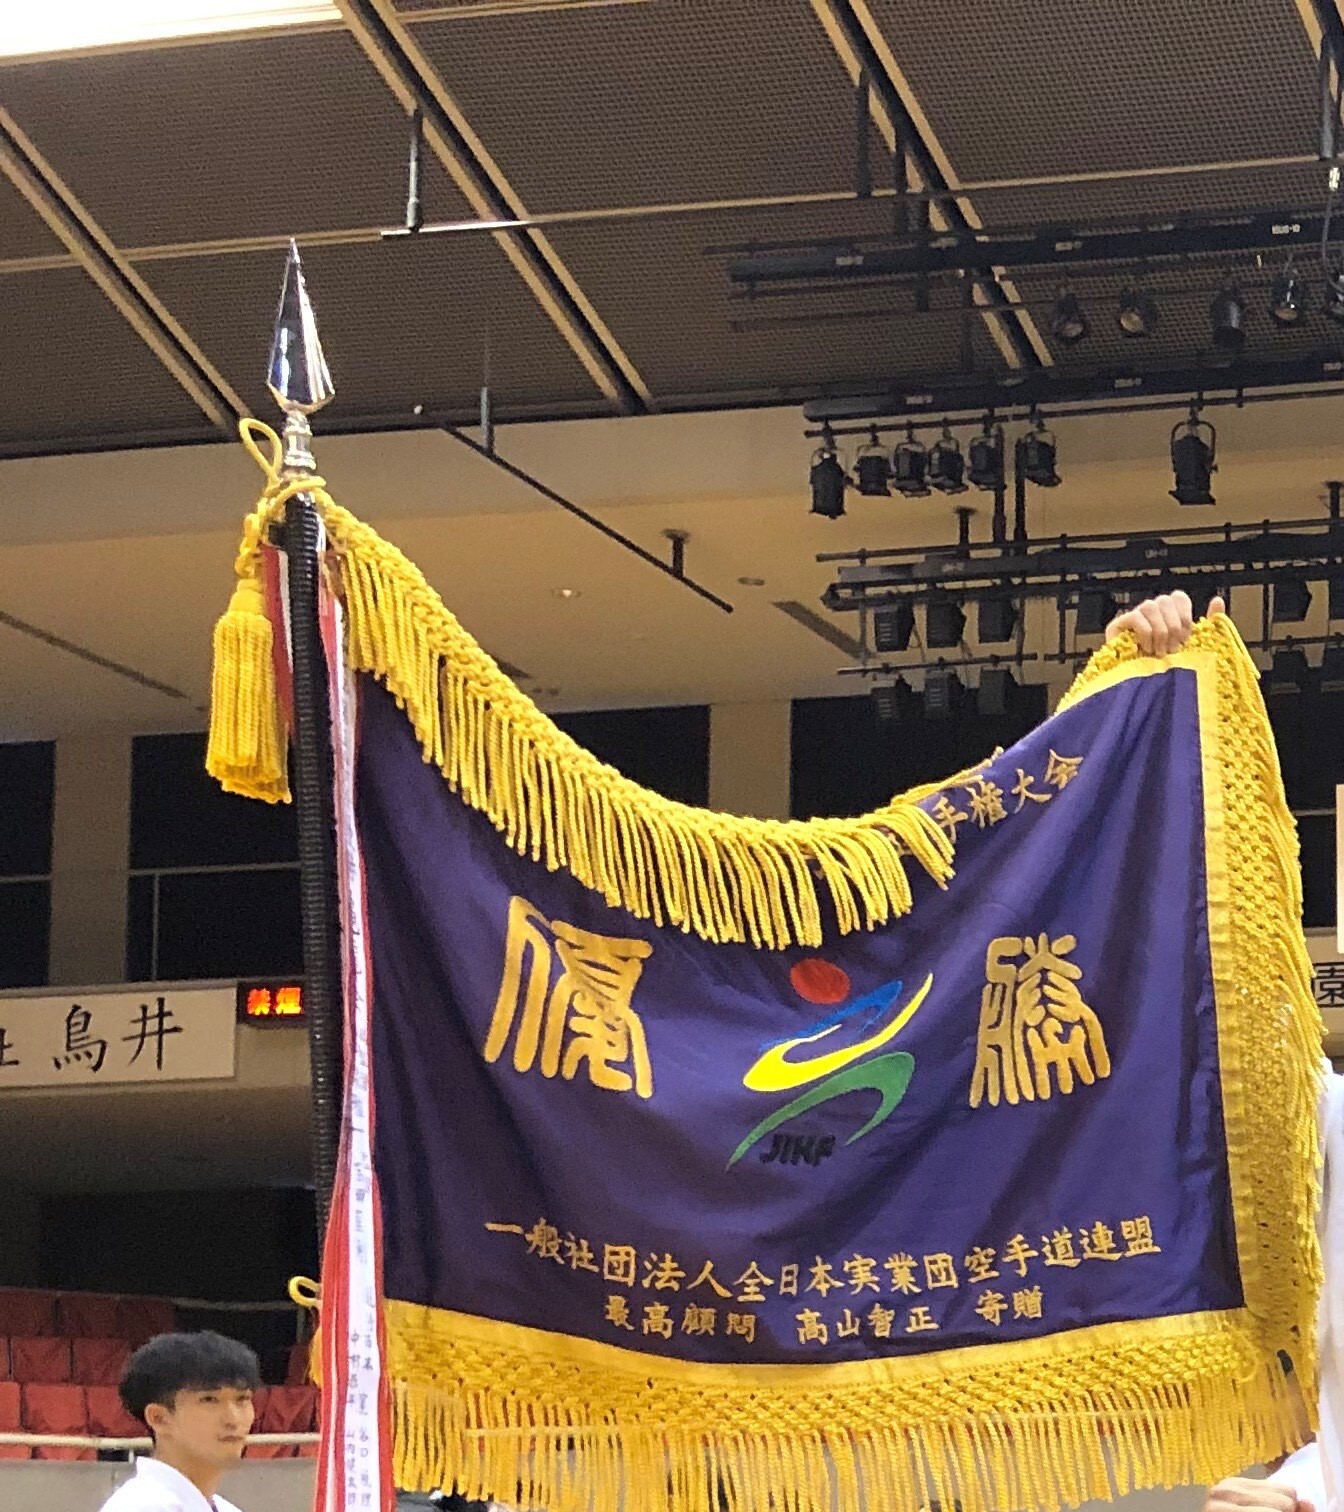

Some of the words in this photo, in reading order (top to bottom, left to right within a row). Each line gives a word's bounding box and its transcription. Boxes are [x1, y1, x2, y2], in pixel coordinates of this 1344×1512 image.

[484, 1216, 1162, 1304] 一般社団法人全日本実業団空手道連盟
[605, 1301, 757, 1344] 最高顧問
[975, 1287, 1044, 1324] 寄贈
